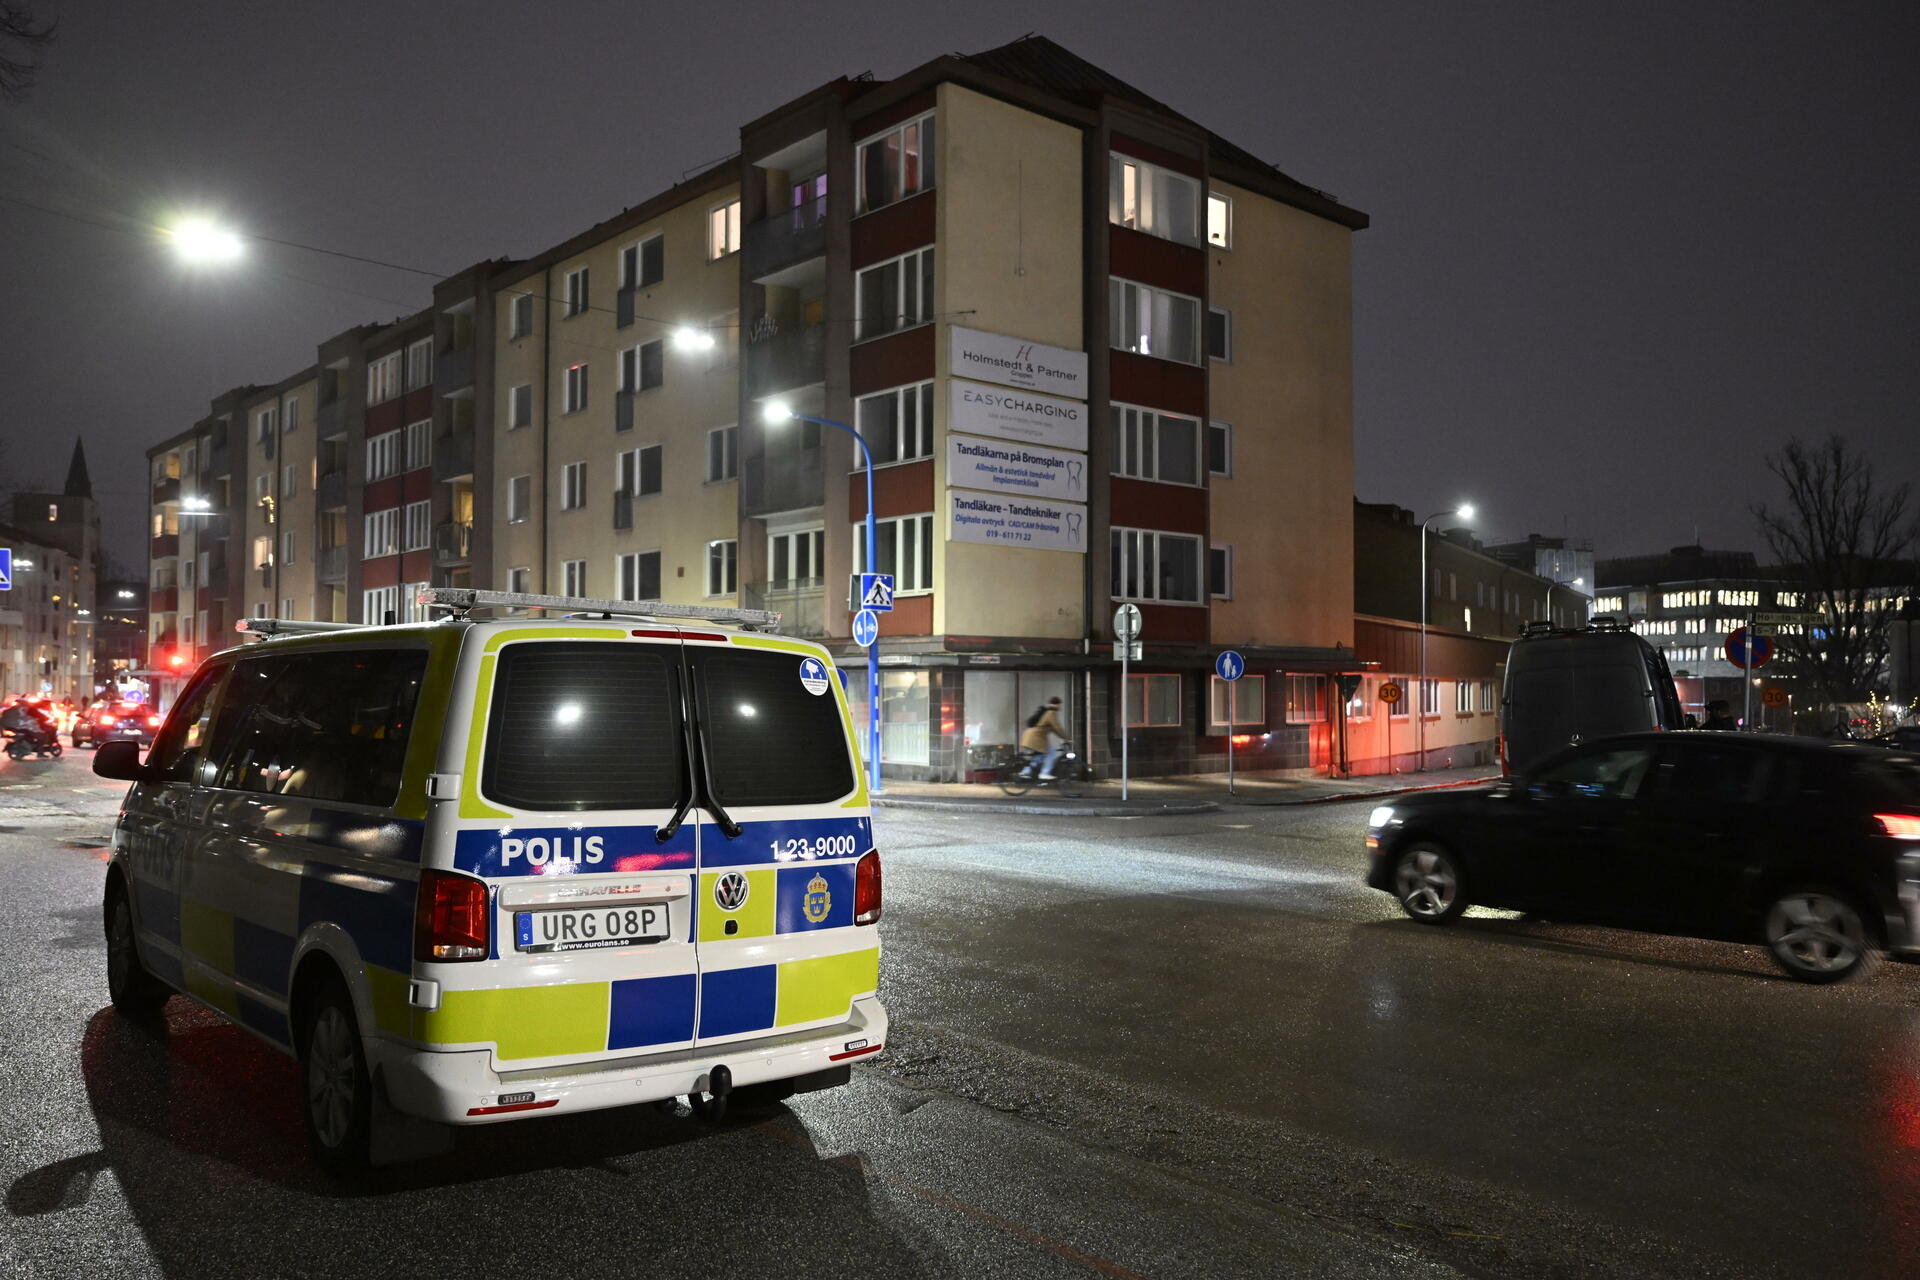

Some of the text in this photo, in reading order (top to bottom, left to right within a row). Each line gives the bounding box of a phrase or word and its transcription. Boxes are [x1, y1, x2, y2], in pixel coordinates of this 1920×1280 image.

[963, 350, 1078, 381] Holmstedt & Partner
[963, 390, 1078, 420] EASYCHARGING
[957, 443, 1065, 468] Tandläkarna på Bromsplan
[976, 463, 998, 474] Allmän
[955, 498, 1002, 513] Tandläkare
[1008, 503, 1061, 520] Tandtekniker
[1383, 687, 1397, 698] 30
[1767, 692, 1783, 702] 30
[501, 836, 604, 867] POLIS
[770, 835, 856, 860] 1 23-9000
[542, 909, 656, 941] URG 08P
[522, 933, 529, 941] S
[561, 938, 630, 951] www.eurolans.se
